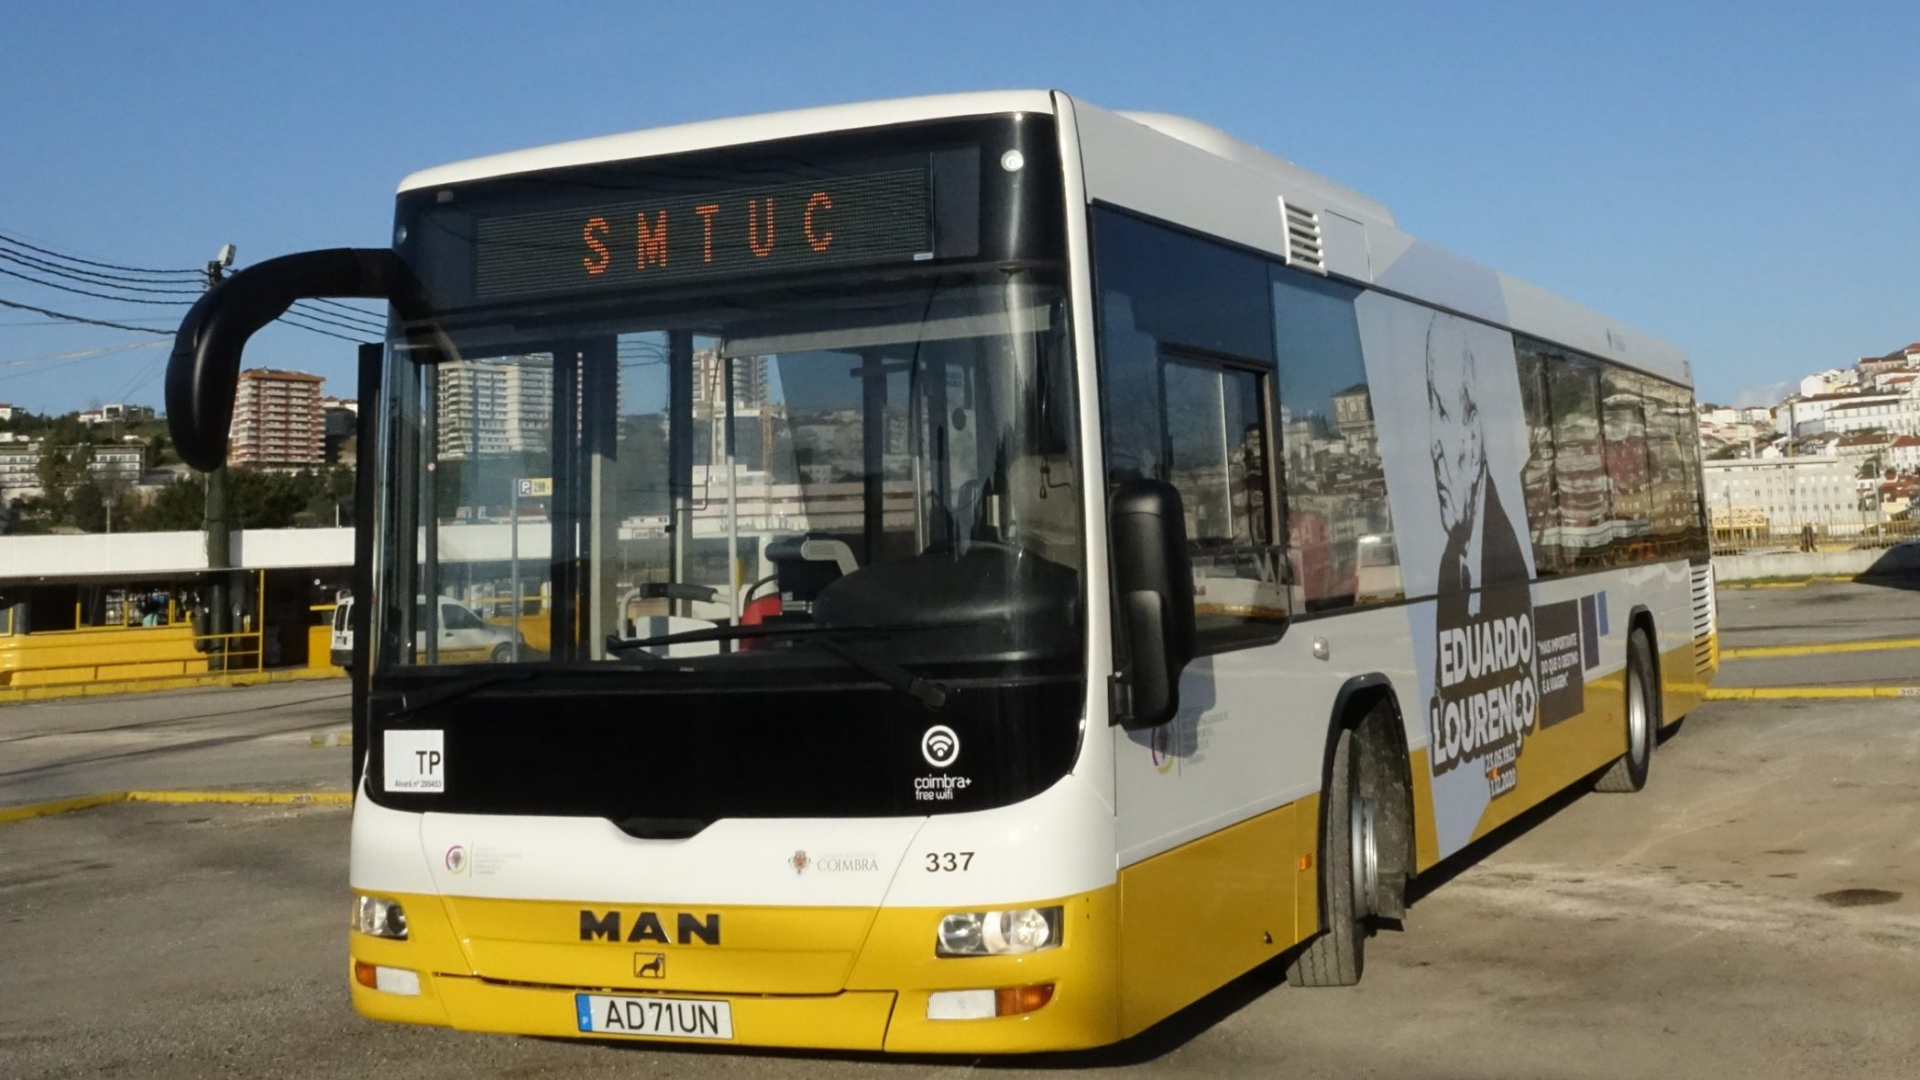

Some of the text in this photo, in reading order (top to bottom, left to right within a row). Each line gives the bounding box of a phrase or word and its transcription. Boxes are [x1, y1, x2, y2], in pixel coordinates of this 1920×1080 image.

[583, 191, 833, 275] SMTUC
[1439, 613, 1532, 687] EDUARDO
[1431, 677, 1536, 766] LOURENÇO
[415, 750, 441, 775] TP
[915, 787, 953, 801] free wifi
[817, 858, 879, 872] COIMBRA
[925, 852, 975, 873] 337
[580, 910, 721, 945] MAN
[605, 999, 719, 1035] AD71UN
